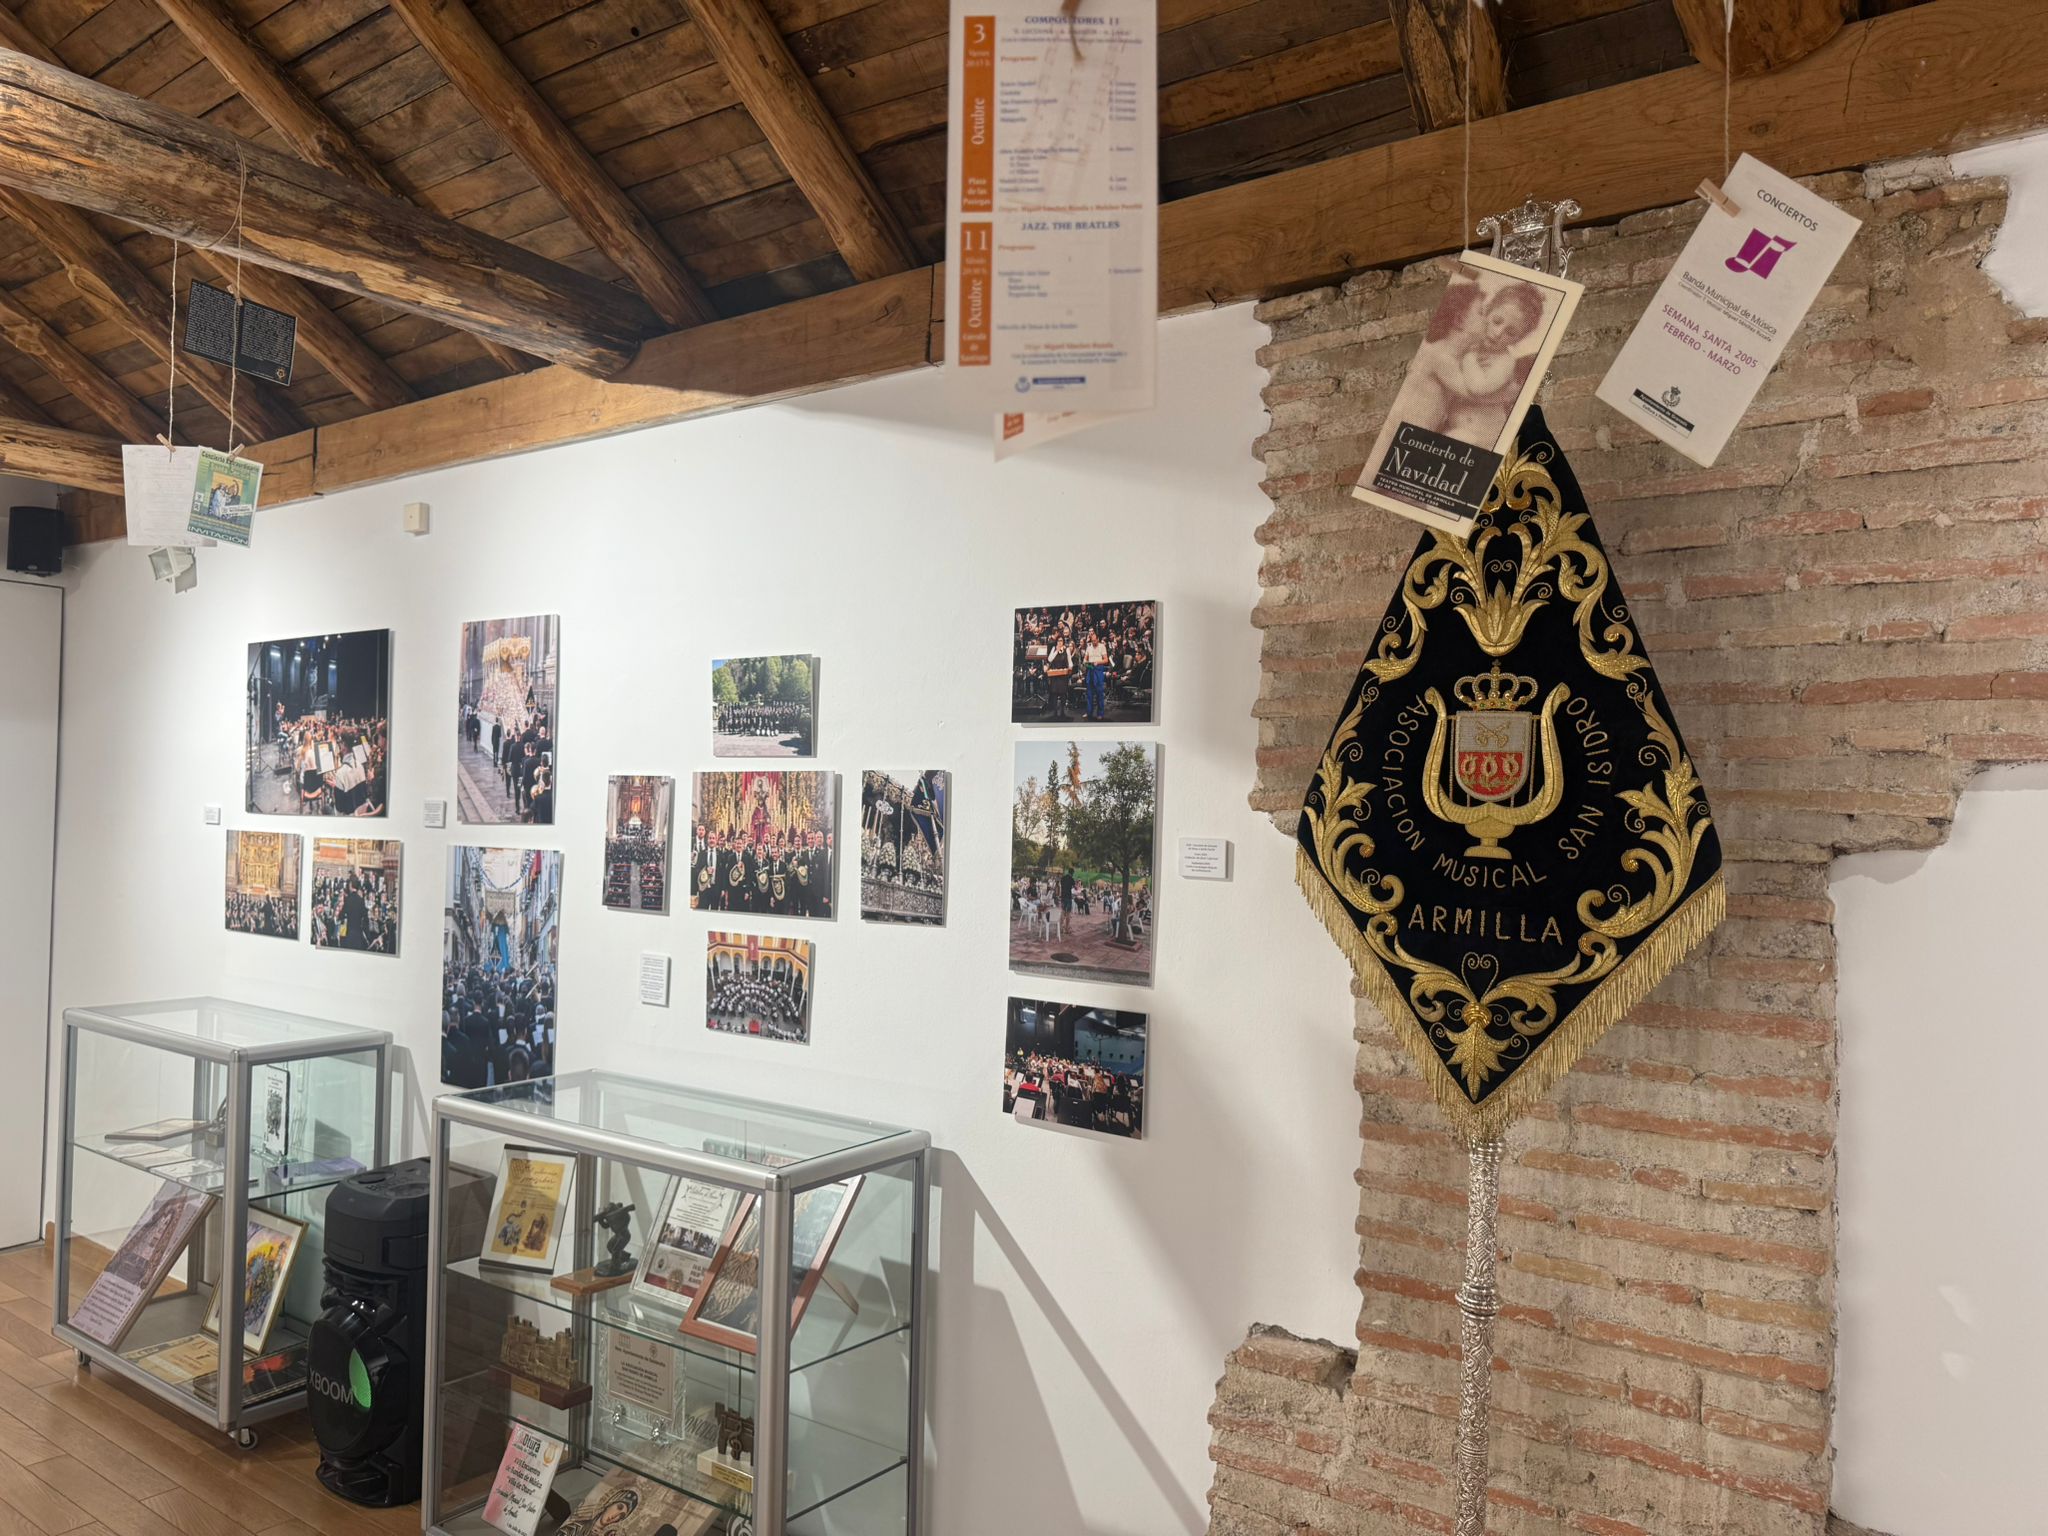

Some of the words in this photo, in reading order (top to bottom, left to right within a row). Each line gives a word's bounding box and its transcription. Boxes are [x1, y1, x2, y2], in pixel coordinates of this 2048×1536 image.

[973, 23, 986, 44] 3
[1024, 15, 1105, 25] COMPOSTORES
[971, 97, 986, 146] Octubre
[1053, 222, 1072, 231] THE
[1075, 220, 1120, 230] BEATLES
[1756, 189, 1819, 232] CONCIERTOS
[965, 230, 988, 251] 11
[968, 278, 982, 328] Octubre
[1682, 271, 1706, 292] Banda
[1704, 283, 1742, 315] Municipal
[1739, 304, 1752, 318] de
[1750, 311, 1778, 336] Música
[1662, 303, 1700, 334] SEMANA
[1701, 329, 1733, 354] SANTA
[1734, 348, 1758, 369] 2005
[1663, 321, 1702, 352] FEBRERO
[1707, 350, 1742, 376] MARZO
[1399, 426, 1456, 461] Concierto
[1459, 448, 1475, 467] de
[1384, 446, 1469, 496] Navidad
[1432, 495, 1455, 506] ARMILLA
[1566, 697, 1613, 786] ISIDRO
[1382, 694, 1429, 851] ASOCIACION
[1558, 804, 1604, 860] SAN
[1432, 853, 1547, 889] MUSICAL
[1407, 903, 1563, 946] ARMILLA
[310, 1368, 354, 1405] XBOOM
[522, 1433, 541, 1454] Otura
